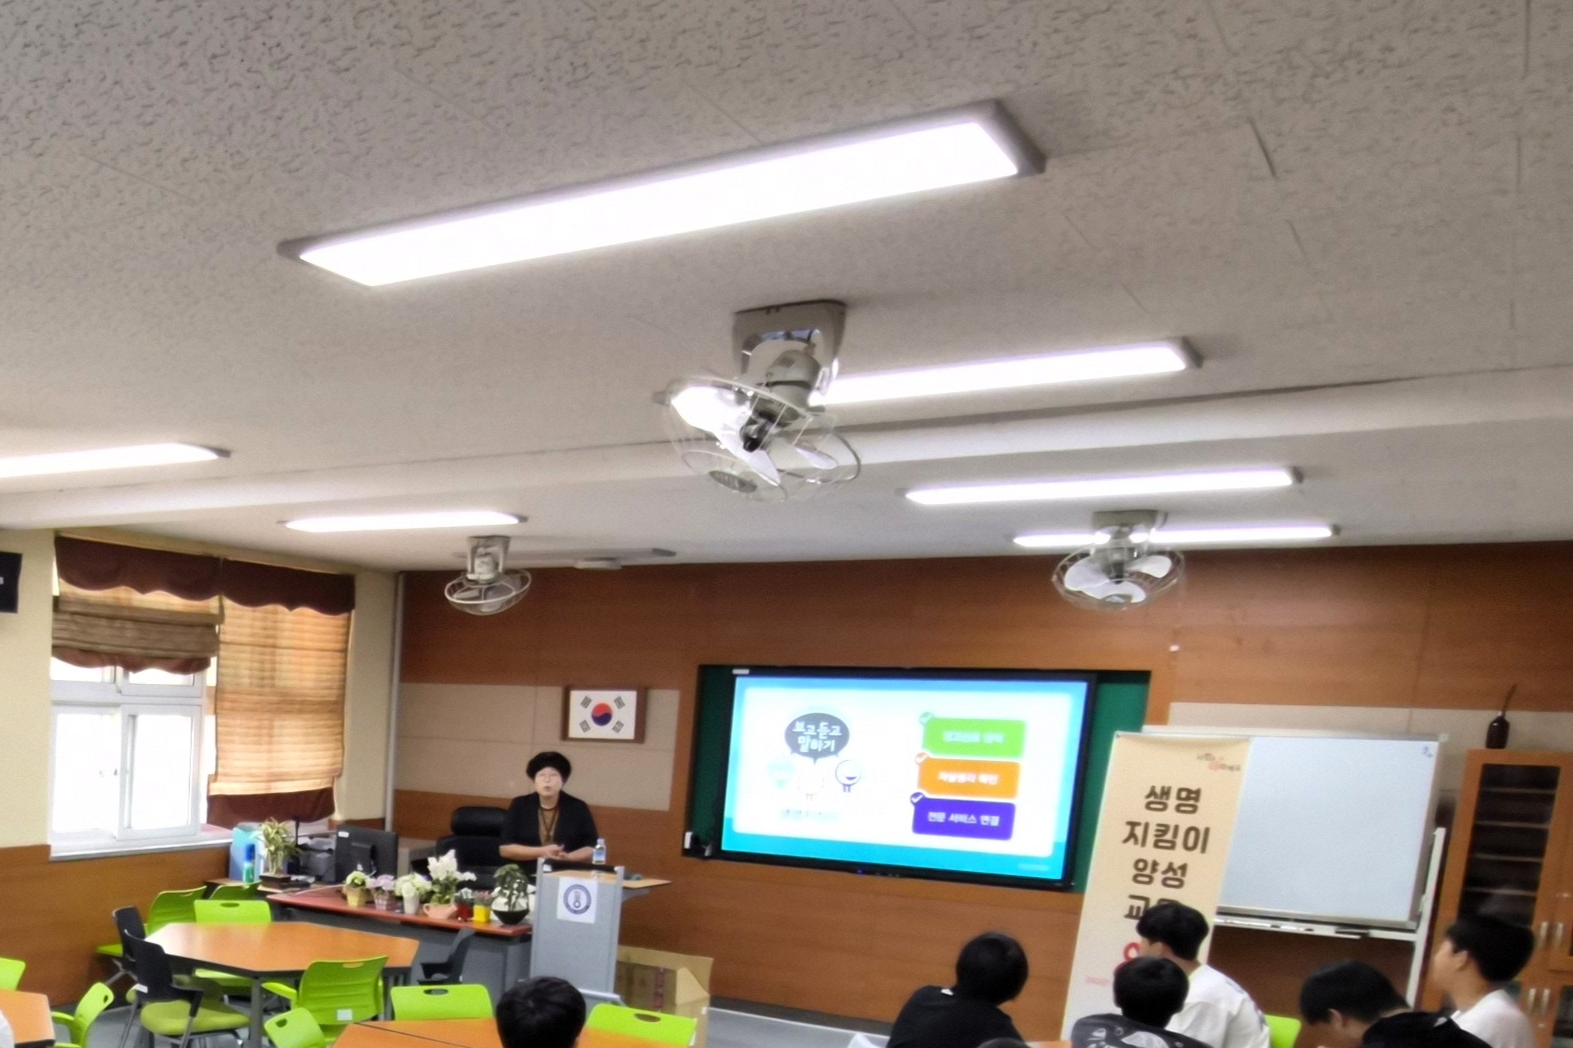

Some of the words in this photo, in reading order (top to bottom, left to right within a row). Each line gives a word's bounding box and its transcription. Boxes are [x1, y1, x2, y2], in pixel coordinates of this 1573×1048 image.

[797, 736, 836, 753] 말하기
[1144, 785, 1202, 814] 생명
[1122, 820, 1211, 854] 지킴이
[1132, 858, 1188, 889] 양성
